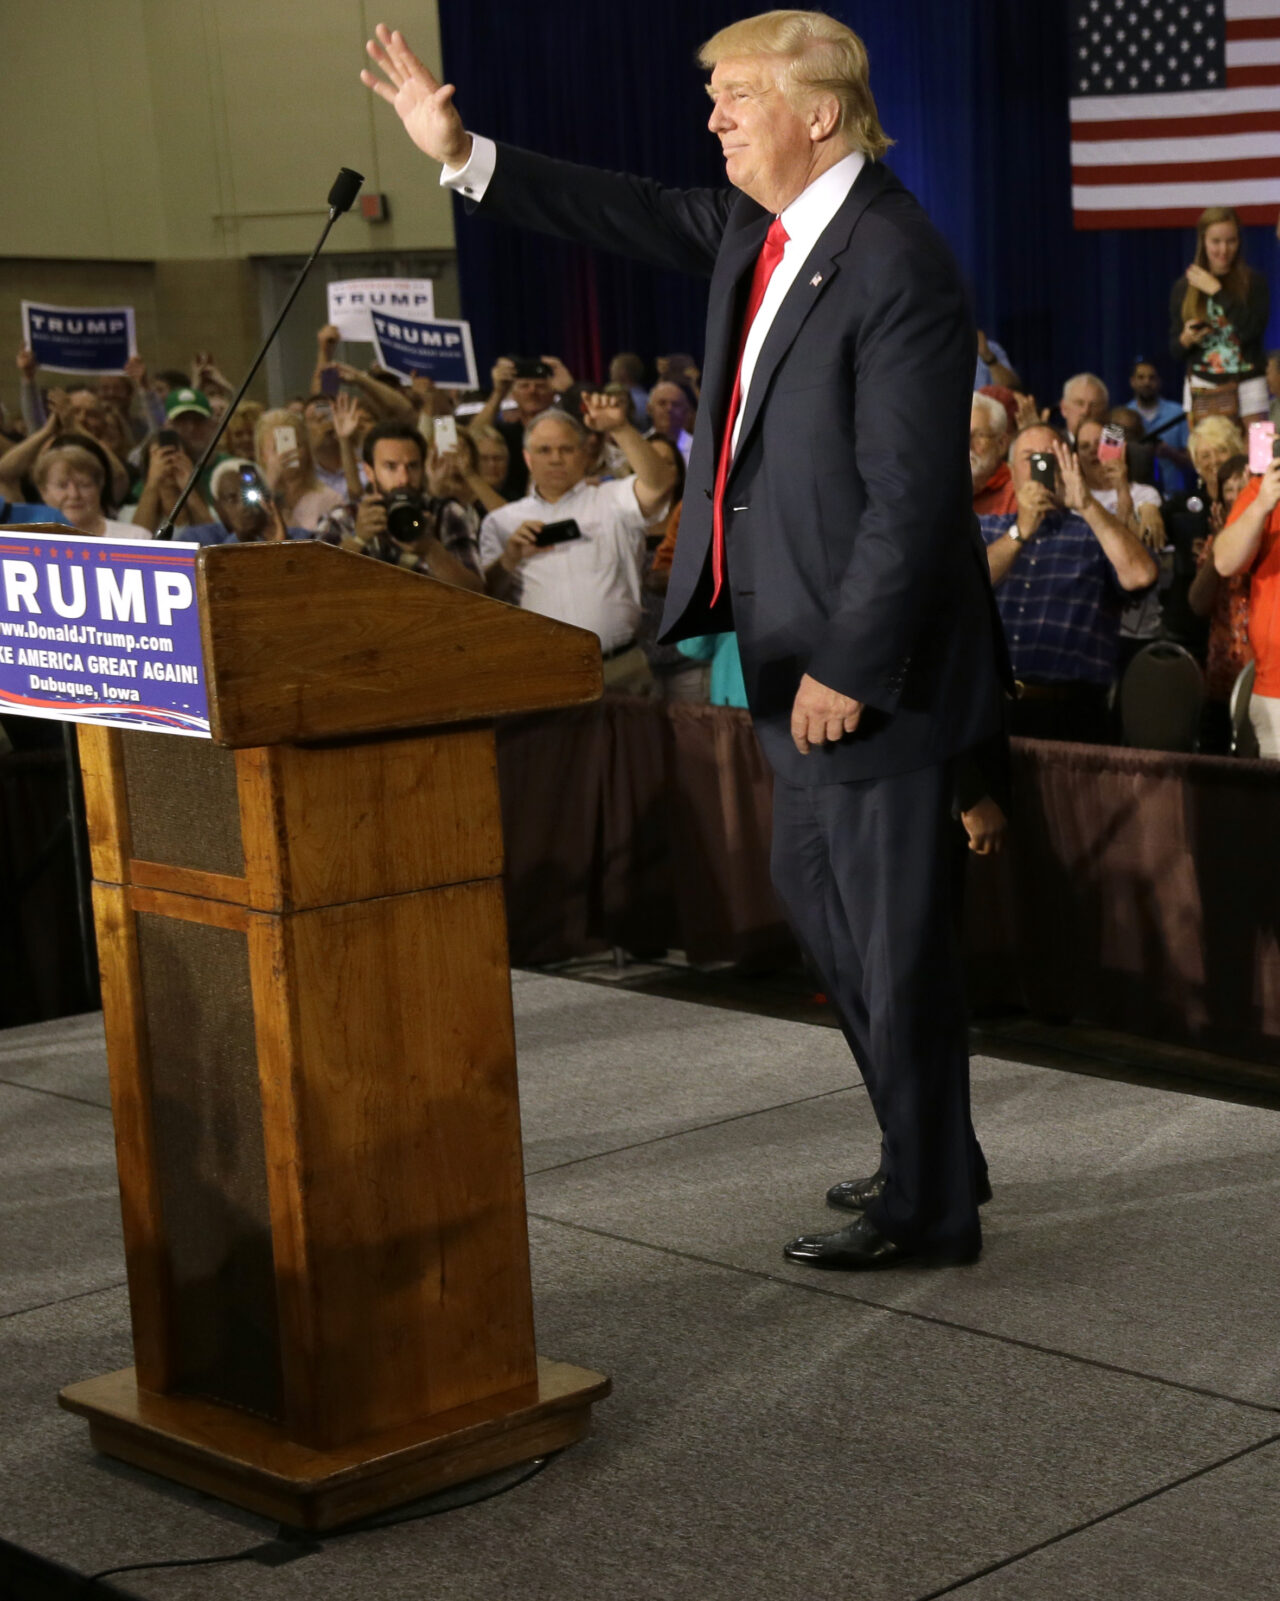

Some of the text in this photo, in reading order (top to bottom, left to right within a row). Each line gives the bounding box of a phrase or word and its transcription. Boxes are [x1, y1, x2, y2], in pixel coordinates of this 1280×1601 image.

[334, 293, 428, 307] TRUMP
[31, 313, 125, 335] TRUMP
[375, 318, 461, 348] TRUMP
[2, 559, 193, 626] RUMP
[0, 620, 174, 652] ww.DonaldJTrump.com
[18, 648, 85, 673] AMERICA
[87, 655, 139, 678] GREAT
[143, 661, 199, 685] AGAIN!
[29, 674, 141, 702] Dubuque, Iowa
